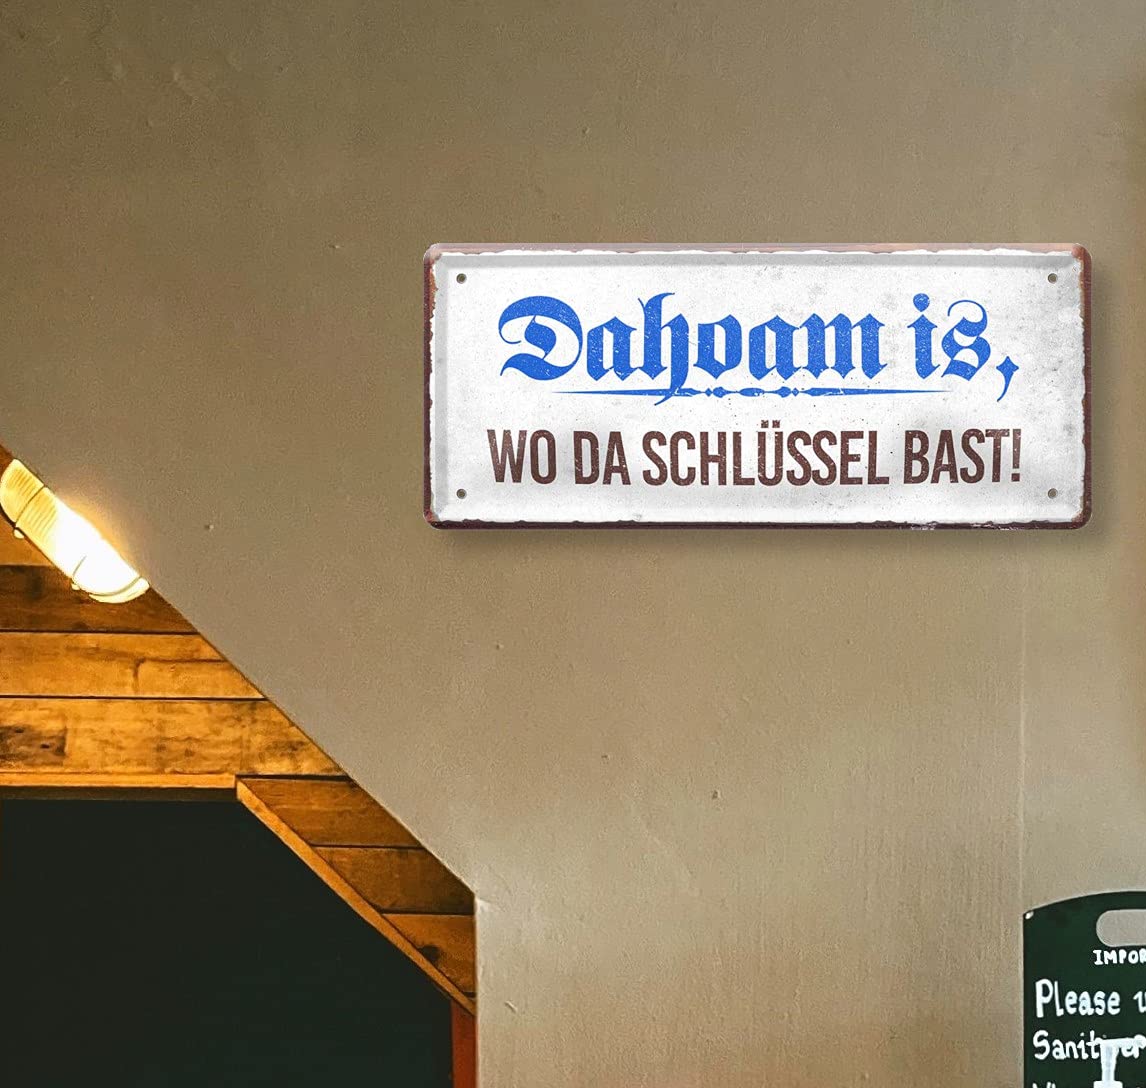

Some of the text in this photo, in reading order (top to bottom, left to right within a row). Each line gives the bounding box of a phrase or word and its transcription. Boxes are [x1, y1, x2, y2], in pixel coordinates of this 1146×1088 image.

[498, 292, 1020, 406] Dahoam is,
[486, 419, 1022, 487] WO DA SCHLÜSSEL BAST!
[1035, 978, 1121, 1018] Please
